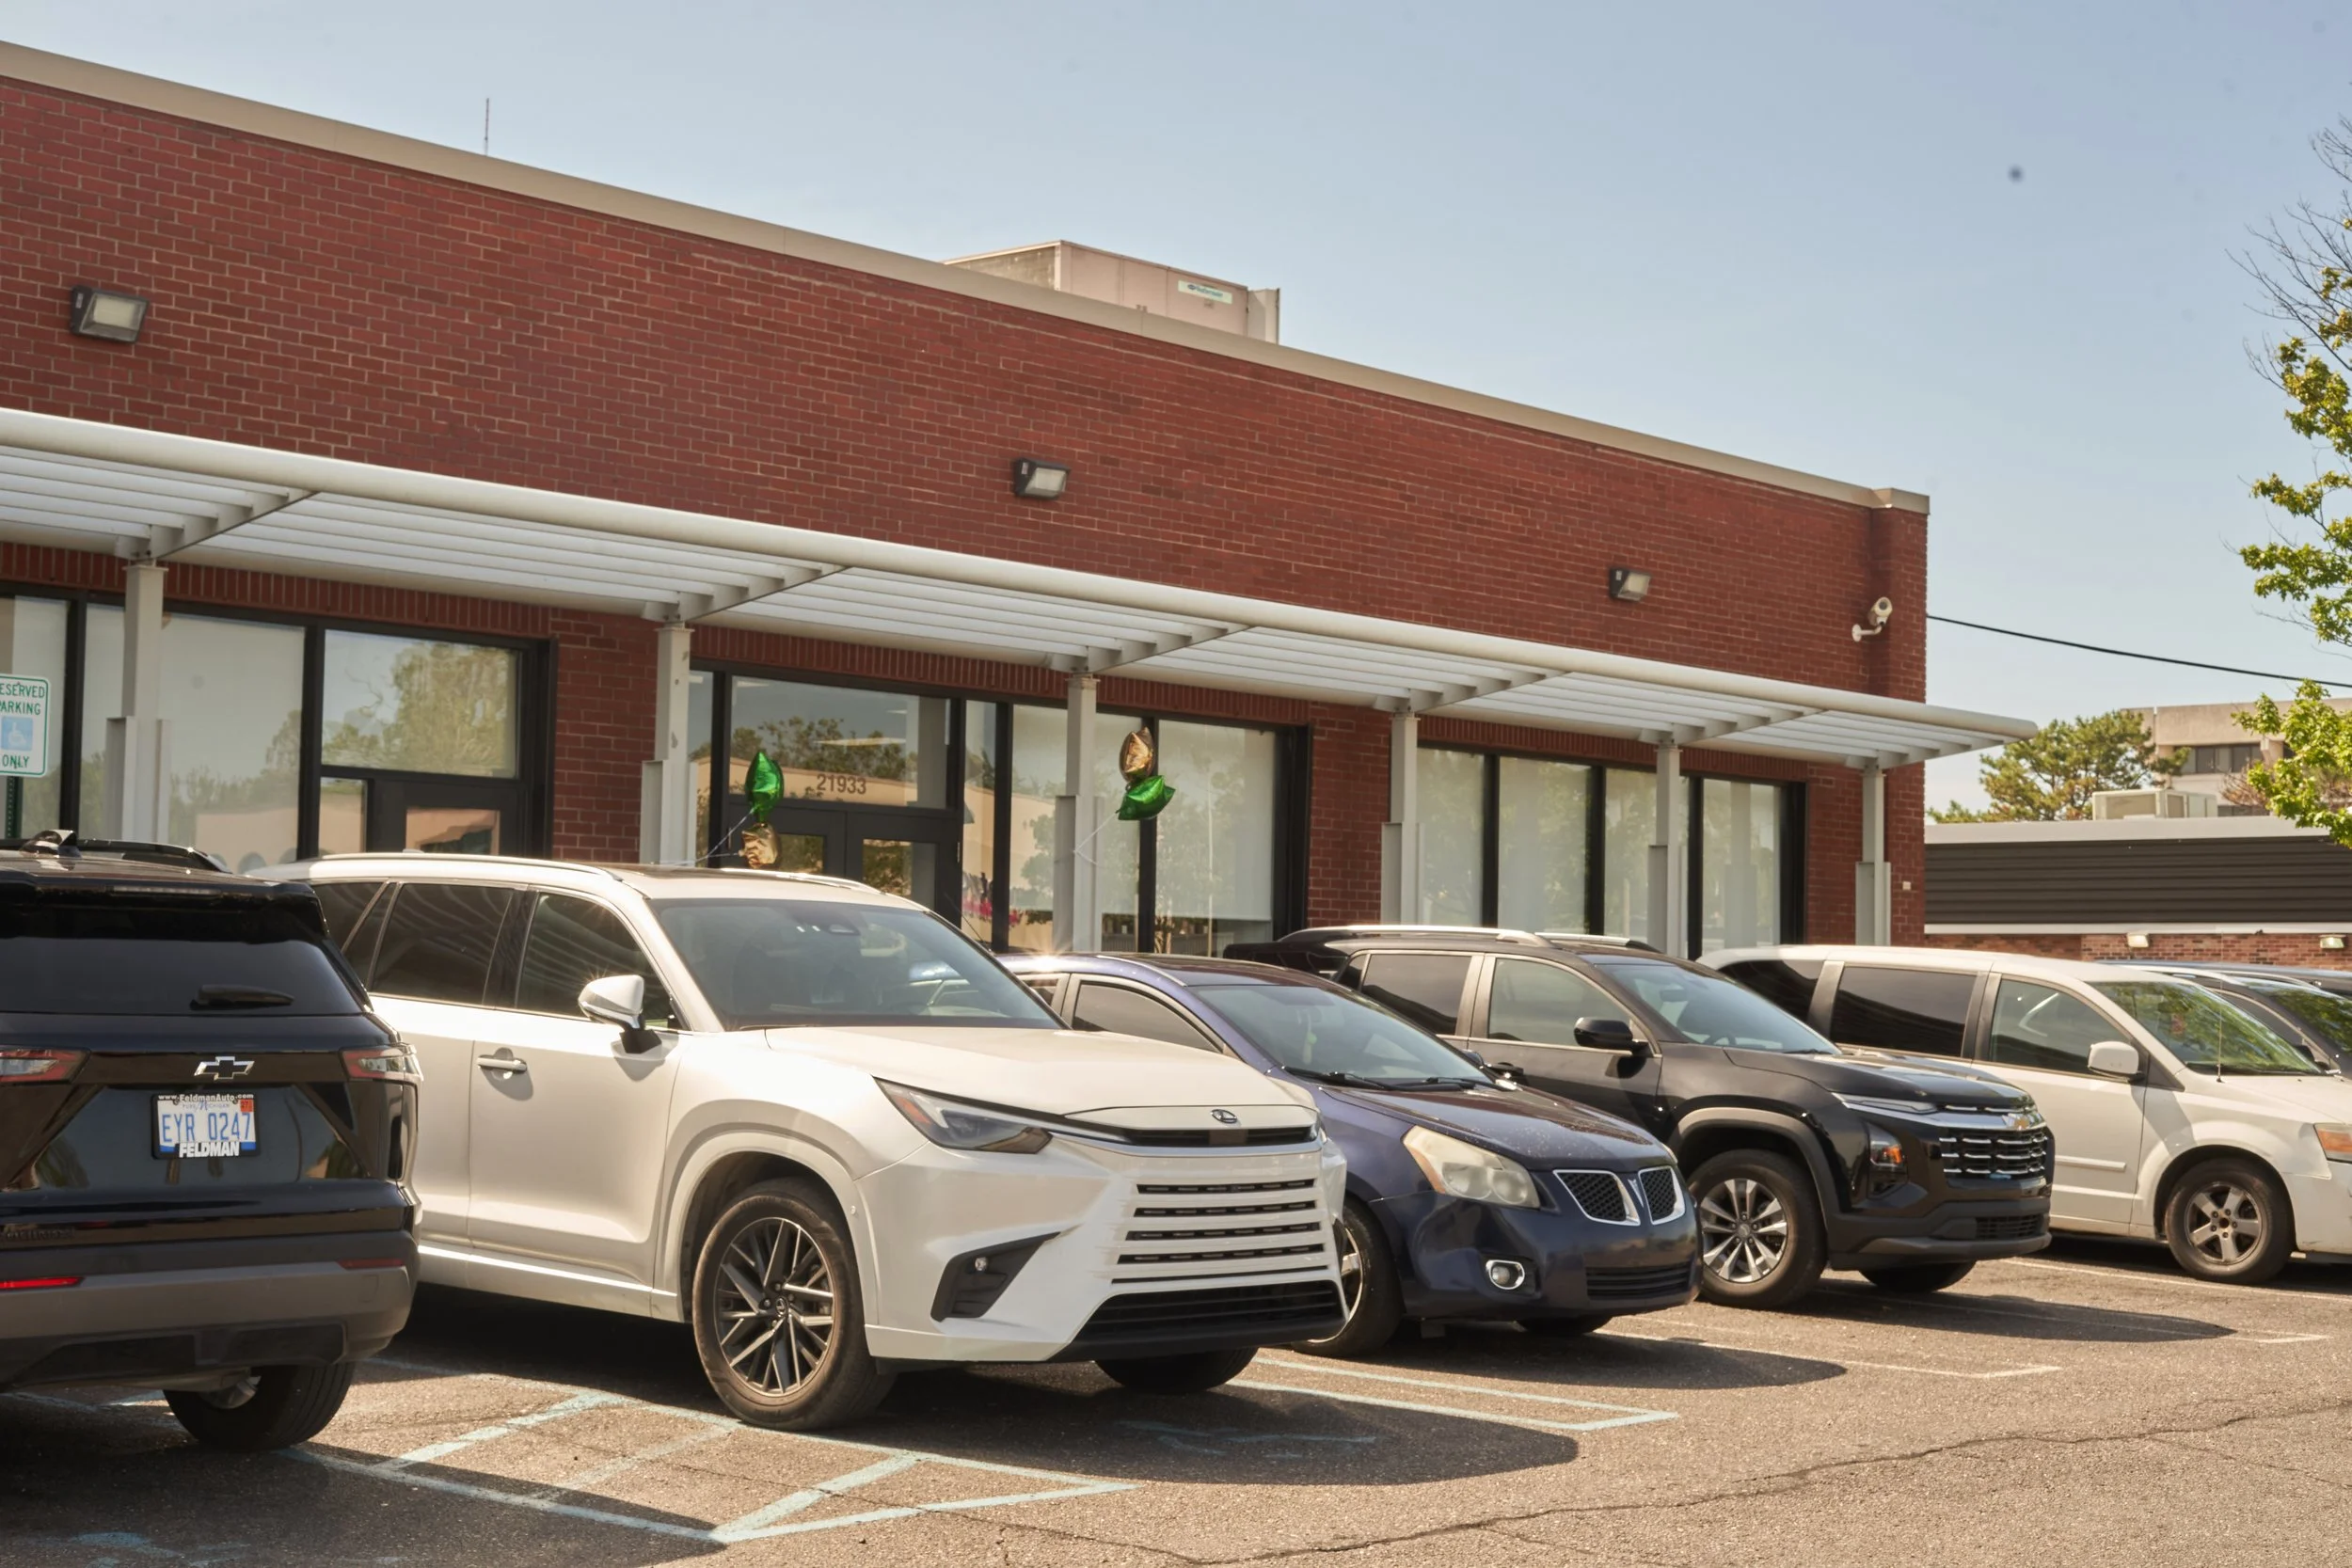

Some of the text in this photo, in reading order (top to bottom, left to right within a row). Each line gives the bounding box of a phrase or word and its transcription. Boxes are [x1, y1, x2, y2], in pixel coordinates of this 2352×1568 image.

[0, 683, 45, 699] ESERVED
[0, 700, 41, 716] ARKING
[2, 754, 29, 768] ONLY
[817, 773, 866, 795] 21933
[158, 1094, 254, 1102] www.FeldmanAuto.com
[162, 1112, 250, 1143] EYR 0247
[179, 1141, 240, 1158] FELDMAN
